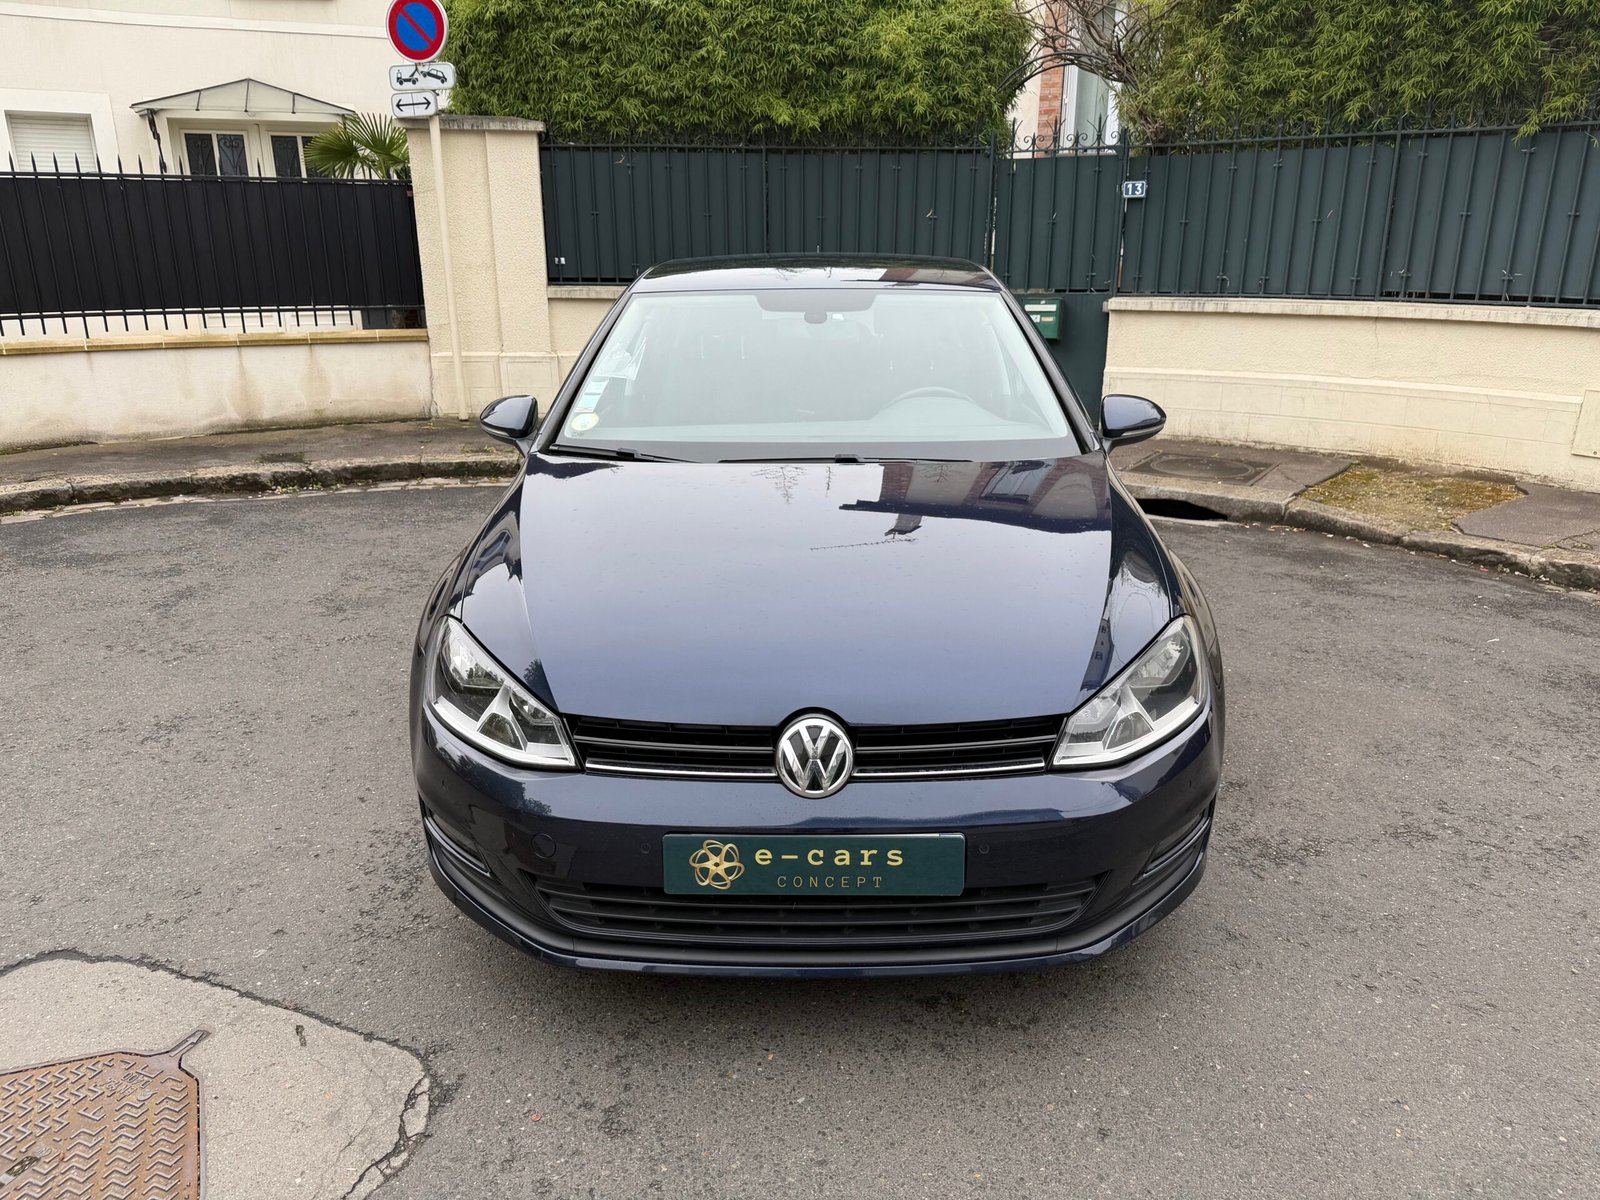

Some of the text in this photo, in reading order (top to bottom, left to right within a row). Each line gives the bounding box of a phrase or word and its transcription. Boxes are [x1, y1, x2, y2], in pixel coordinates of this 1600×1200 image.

[1127, 183, 1142, 195] 13
[754, 848, 903, 866] e-cars
[777, 876, 882, 888] CONCEPT
